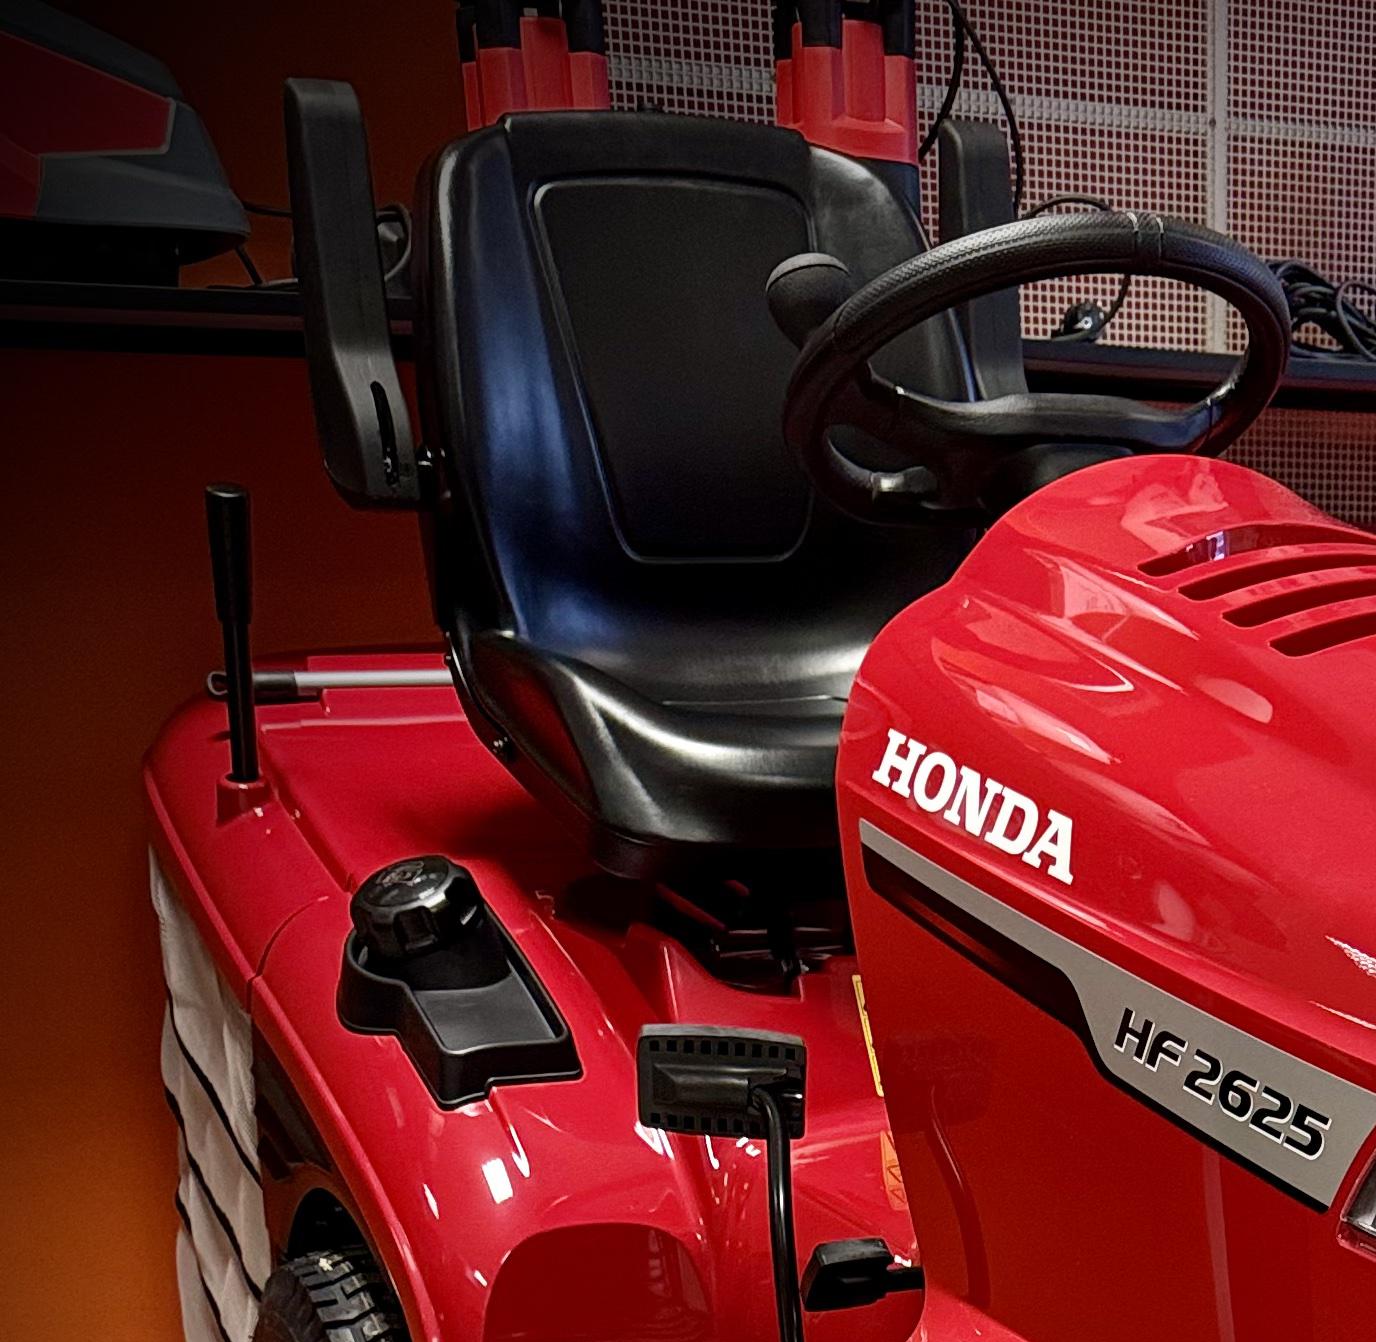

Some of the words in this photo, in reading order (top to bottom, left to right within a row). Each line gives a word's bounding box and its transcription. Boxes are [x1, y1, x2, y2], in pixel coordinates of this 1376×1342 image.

[872, 727, 1074, 885] HONDA
[1113, 1007, 1188, 1073] HF
[1182, 1048, 1333, 1161] 2625
